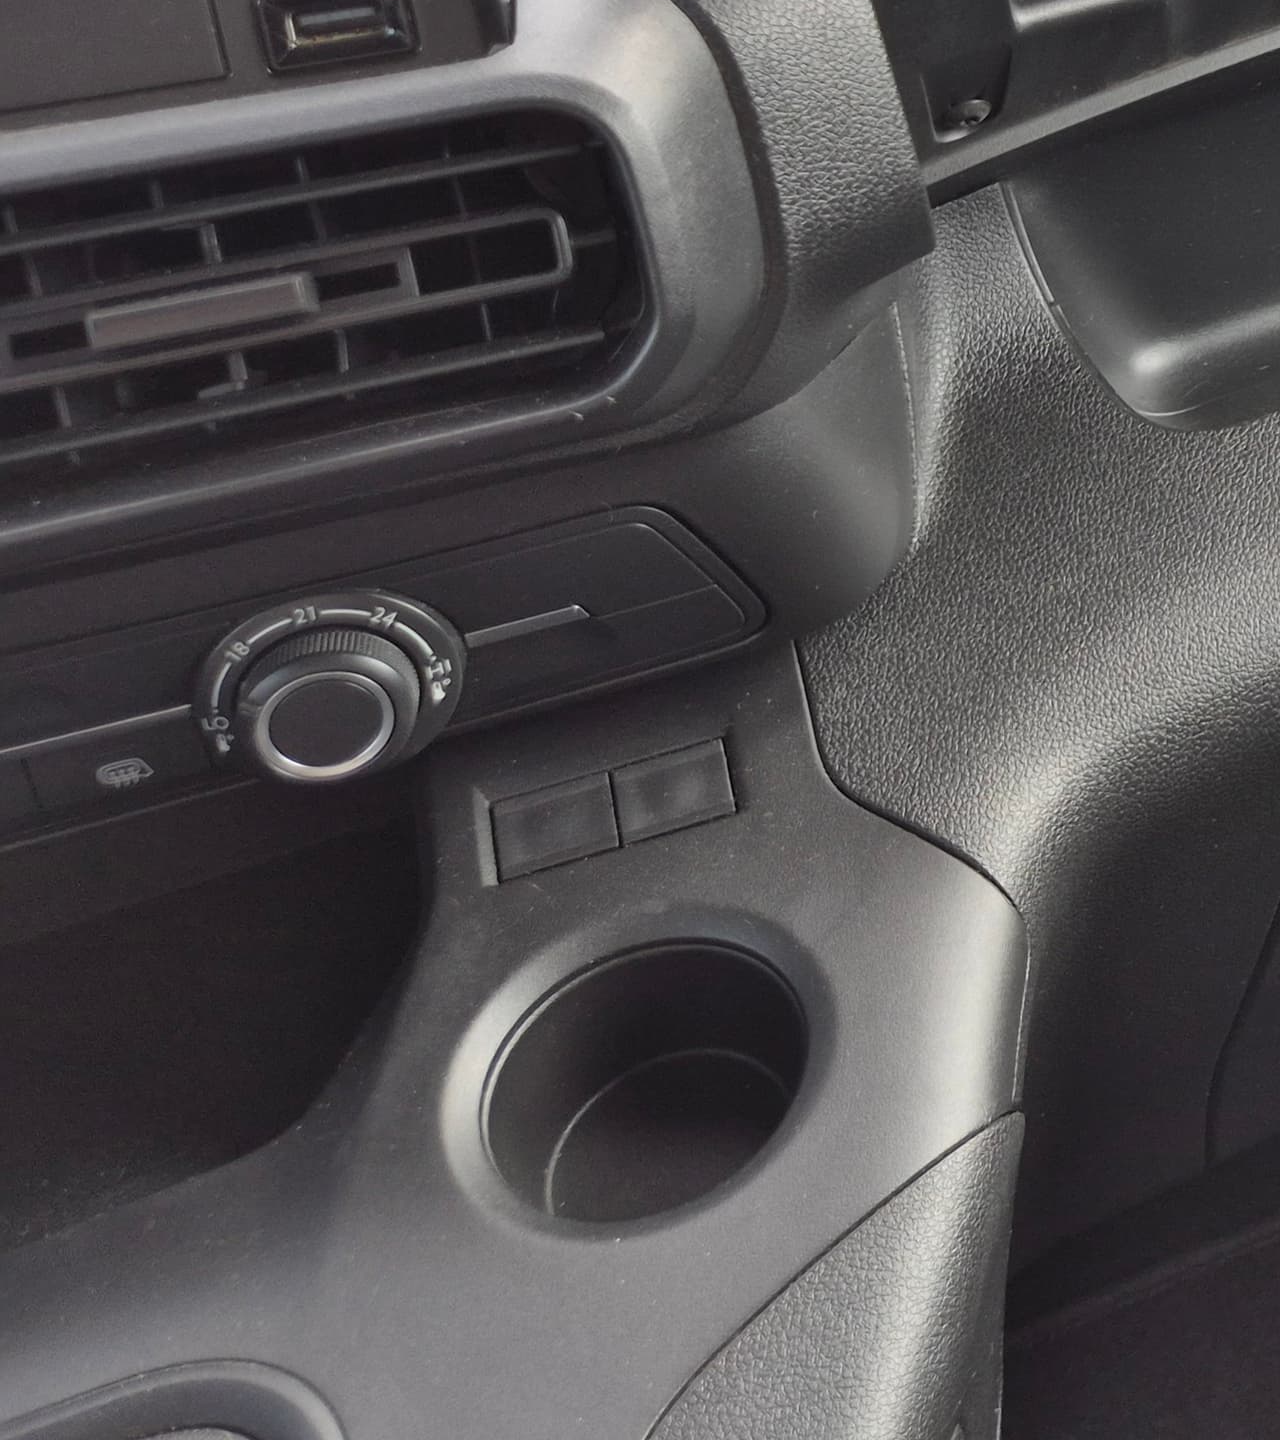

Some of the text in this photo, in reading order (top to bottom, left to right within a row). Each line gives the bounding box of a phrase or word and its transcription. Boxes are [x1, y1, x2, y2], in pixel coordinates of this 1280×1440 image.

[293, 606, 316, 624] 21
[370, 606, 398, 628] 24
[223, 641, 250, 662] 18
